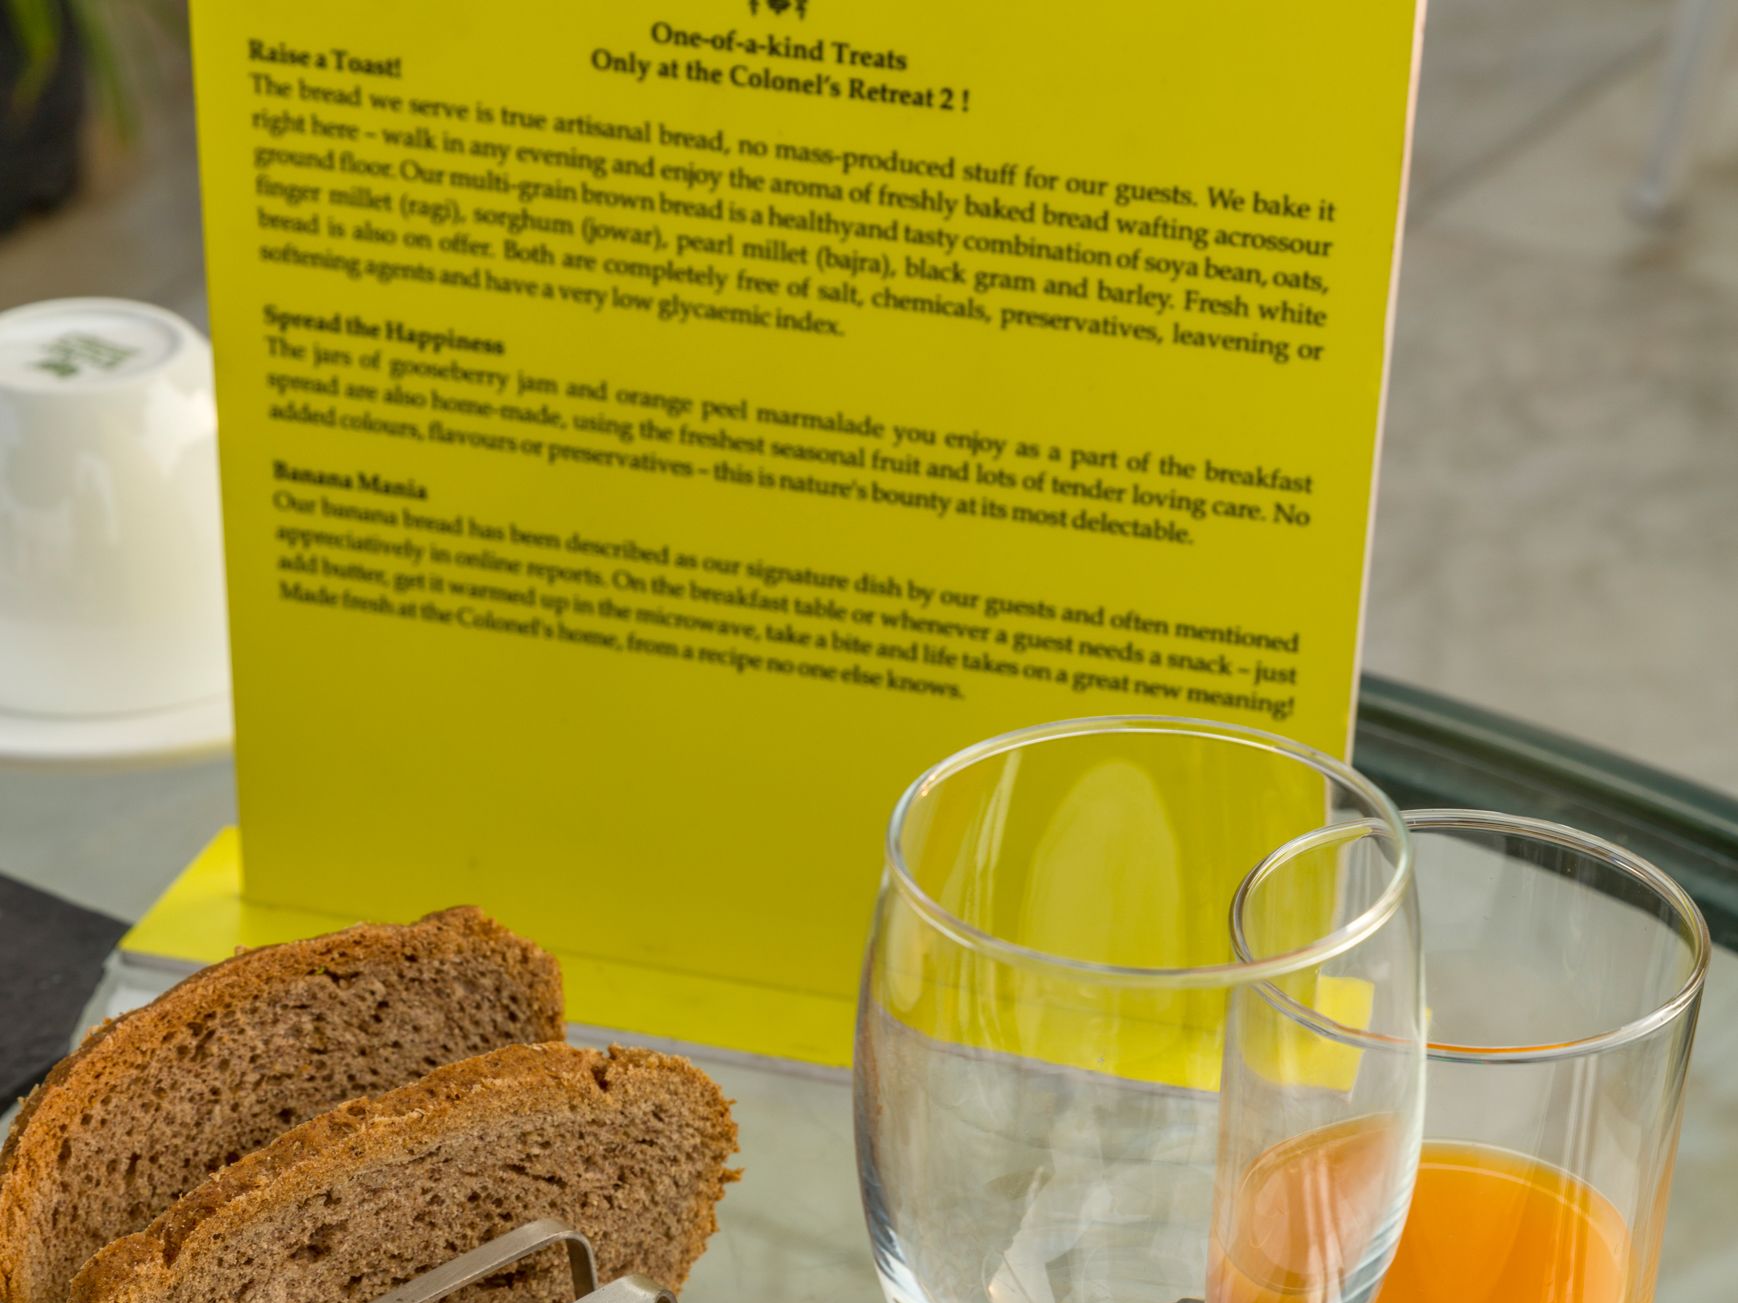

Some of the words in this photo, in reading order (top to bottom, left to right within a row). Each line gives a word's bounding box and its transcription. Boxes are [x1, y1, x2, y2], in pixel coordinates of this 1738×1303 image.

[247, 37, 311, 67] Raise
[314, 53, 327, 70] a
[330, 48, 401, 79] Toast!
[590, 47, 650, 80] Only
[657, 59, 679, 79] at
[685, 58, 722, 85] the
[728, 64, 841, 98] Colonel's
[847, 77, 934, 108] Retreat
[939, 86, 954, 111] 2
[961, 88, 970, 112] !
[650, 20, 824, 62] One-of-a-kind
[830, 41, 907, 71] Treats
[249, 71, 292, 99] The
[297, 77, 362, 108] bread
[408, 98, 469, 121] serve
[499, 106, 546, 130] true
[553, 114, 651, 144] artisanal
[658, 122, 730, 155] bread,
[737, 138, 768, 157] no
[774, 143, 955, 180] mass-produced
[962, 162, 1018, 186] stuff
[1023, 165, 1058, 191] for
[1064, 177, 1107, 197] our
[1114, 182, 1197, 207] guests.
[1207, 185, 1245, 212] We
[1251, 190, 1311, 219] bake
[1317, 199, 1335, 222] it
[251, 108, 306, 138] right
[309, 112, 359, 141] here
[382, 126, 436, 151] walk
[469, 139, 510, 165] any
[515, 145, 607, 177] evening
[611, 155, 656, 179] and
[659, 161, 721, 190] enjoy
[728, 166, 764, 192] the
[770, 177, 844, 201] aroma
[848, 181, 872, 205] of
[877, 183, 957, 219] freshly
[963, 193, 1036, 224] baked
[1041, 202, 1109, 232] bread
[1115, 215, 1209, 249] wafting
[338, 150, 396, 179] floor.
[398, 158, 445, 186] Our
[448, 168, 577, 202] multi-grain
[580, 181, 655, 212] brown
[658, 190, 724, 221] bread
[902, 223, 958, 252] tasty
[962, 233, 1112, 267] combination
[1115, 247, 1141, 271] of
[1143, 255, 1199, 280] soya
[1203, 255, 1267, 288] bean,
[1271, 270, 1329, 295] oats,
[399, 193, 466, 225] (ragi),
[472, 206, 574, 236] sorghum
[580, 216, 667, 250] (jowar),
[676, 233, 734, 256] pearl
[741, 238, 808, 265] millet
[815, 244, 896, 279] (bajra),
[904, 254, 965, 284] black
[973, 270, 1036, 292] gram
[1043, 276, 1088, 299] and
[1096, 277, 1174, 313] barley.
[1183, 288, 1249, 318] Fresh
[1258, 299, 1327, 327] white
[262, 303, 343, 335] Spread
[343, 315, 381, 339] the
[384, 319, 505, 356] Happiness
[483, 268, 538, 297] have
[558, 284, 606, 310] very
[610, 285, 652, 311] low
[657, 293, 771, 328] glycaemic
[774, 307, 843, 336] index.
[502, 238, 555, 266] Both
[603, 257, 727, 292] completely
[736, 268, 779, 295] free
[786, 276, 810, 299] of
[816, 280, 864, 308] salt,
[870, 286, 992, 324] chemicals,
[999, 307, 1163, 344] preservatives,
[1171, 321, 1290, 363] leavening
[1296, 343, 1323, 361] or
[272, 459, 354, 491] Banana
[356, 471, 427, 501] Mania
[678, 423, 765, 455] freshest
[770, 441, 866, 469] seasonal
[870, 448, 921, 476] fruit
[925, 460, 970, 483] and
[975, 462, 1017, 489] lots
[1050, 475, 1126, 503] tender
[1131, 482, 1207, 517] loving
[1211, 499, 1265, 521] care.
[1272, 501, 1310, 527] No
[700, 398, 748, 421] peel
[755, 407, 884, 439] marmalade
[892, 424, 936, 446] you
[943, 430, 1006, 458] enjoy
[1069, 448, 1118, 470] part
[1125, 451, 1151, 473] of
[1158, 454, 1196, 479] the
[1203, 458, 1313, 495] breakfast
[712, 460, 754, 486] this
[778, 474, 868, 501] nature's
[869, 480, 951, 515] bounty
[979, 496, 1008, 520] its
[1010, 505, 1068, 528] most
[1070, 508, 1193, 544] delectable.
[792, 596, 847, 622] table
[880, 609, 990, 642] whenever
[1012, 631, 1074, 654] guest
[1077, 640, 1145, 664] needs
[1166, 652, 1232, 676] snack
[1253, 660, 1297, 685] just
[853, 572, 902, 599] dish
[939, 589, 979, 609] our
[984, 596, 1057, 620] guests
[1060, 605, 1105, 627] and
[1109, 609, 1169, 636] often
[1174, 622, 1300, 654] mentioned
[764, 623, 812, 647] take
[830, 629, 873, 656] bite
[875, 641, 919, 663] and
[921, 642, 958, 668] life
[960, 652, 1020, 677] takes
[1071, 671, 1130, 693] great
[1132, 679, 1181, 699] new
[1185, 686, 1295, 719] meaning!
[885, 668, 963, 699] knows.
